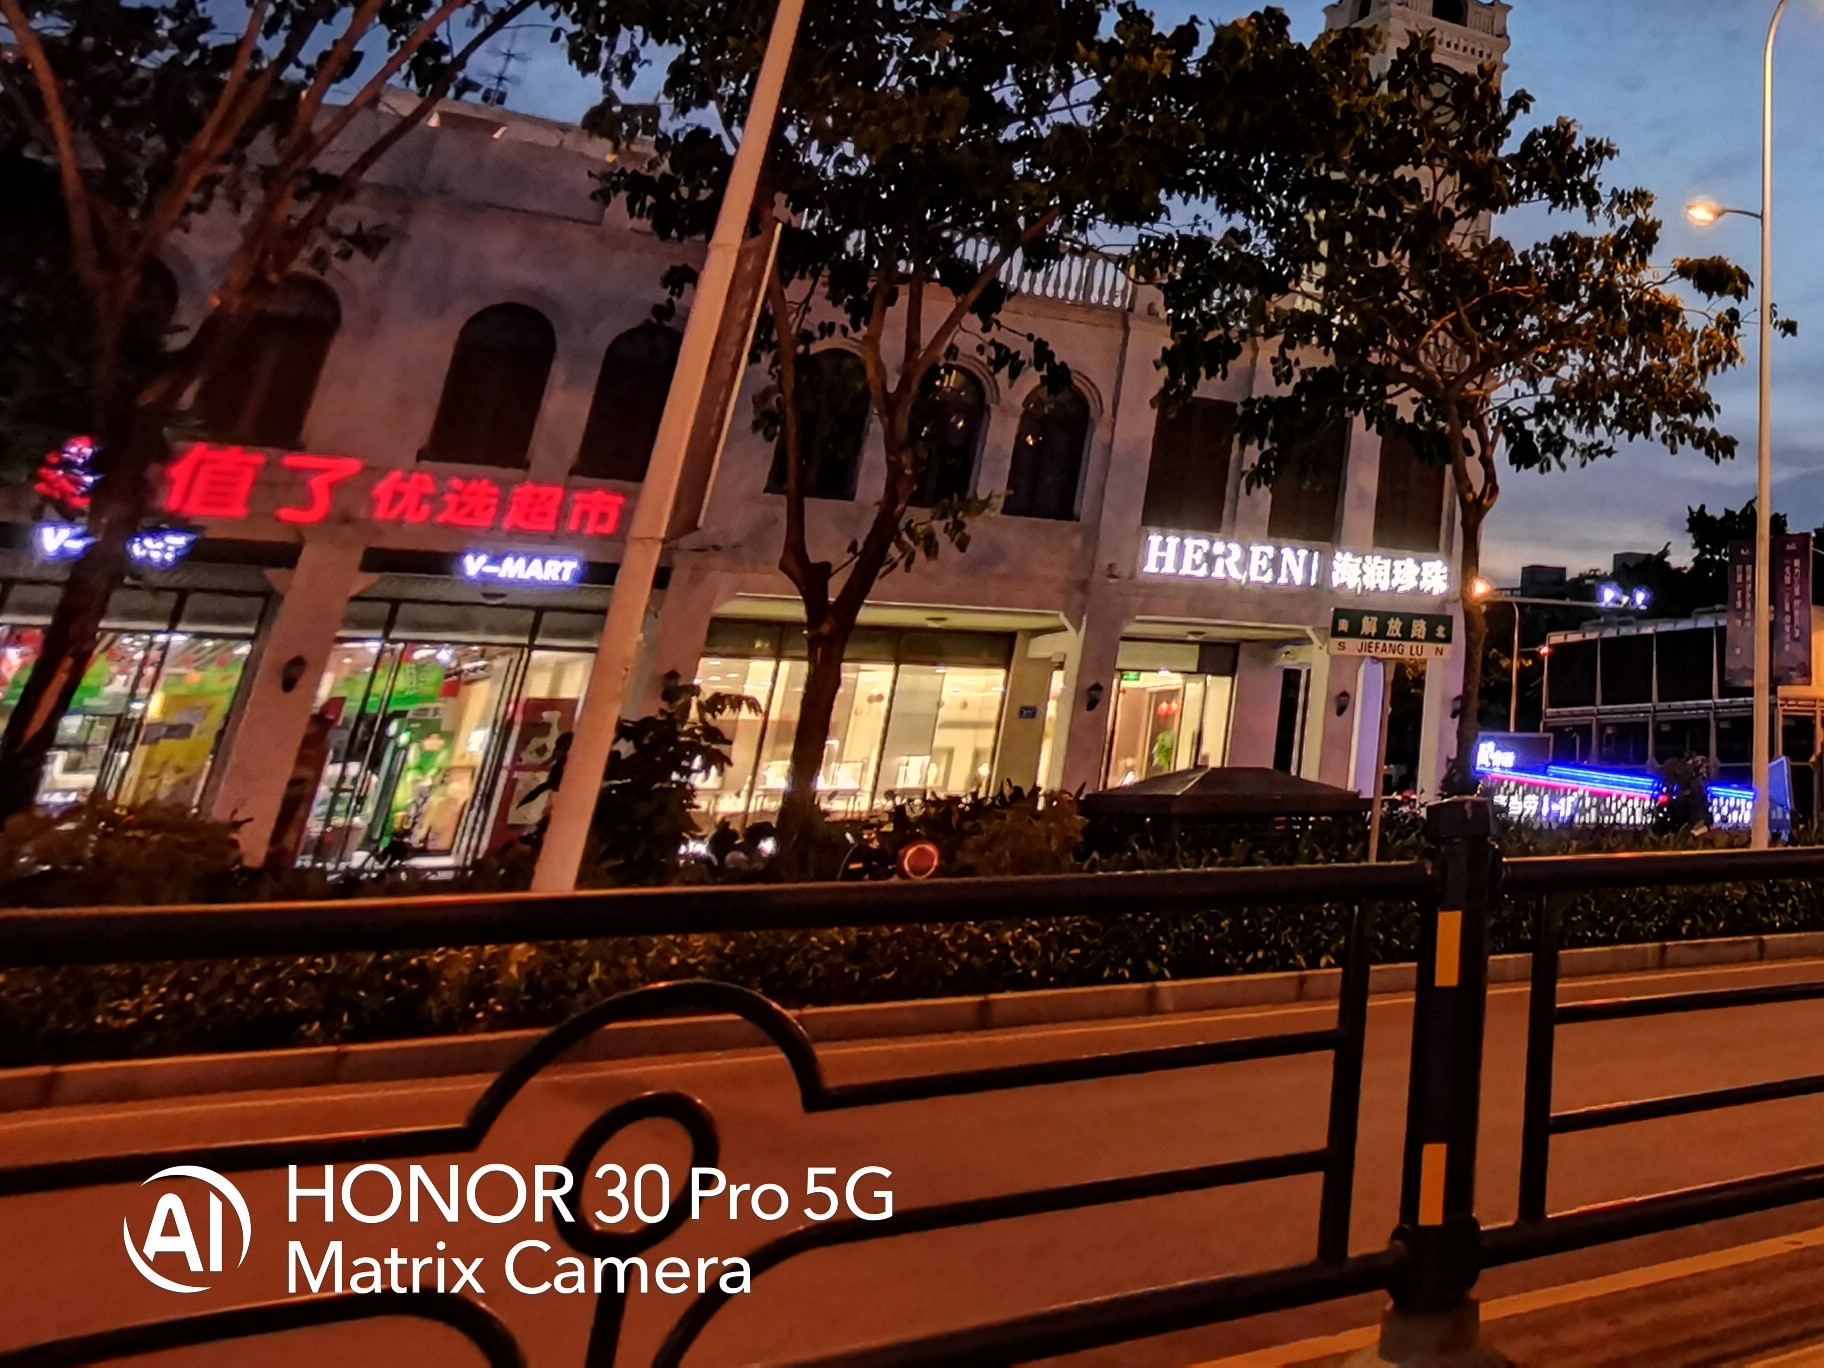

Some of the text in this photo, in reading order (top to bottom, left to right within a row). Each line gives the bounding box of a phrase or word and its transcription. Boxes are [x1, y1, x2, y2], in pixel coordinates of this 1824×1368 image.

[462, 553, 580, 583] V-MART
[1142, 533, 1450, 597] HEREN 海润珍珠
[1359, 615, 1428, 640] 解放路
[1337, 641, 1444, 657] S JIEFANG LU N
